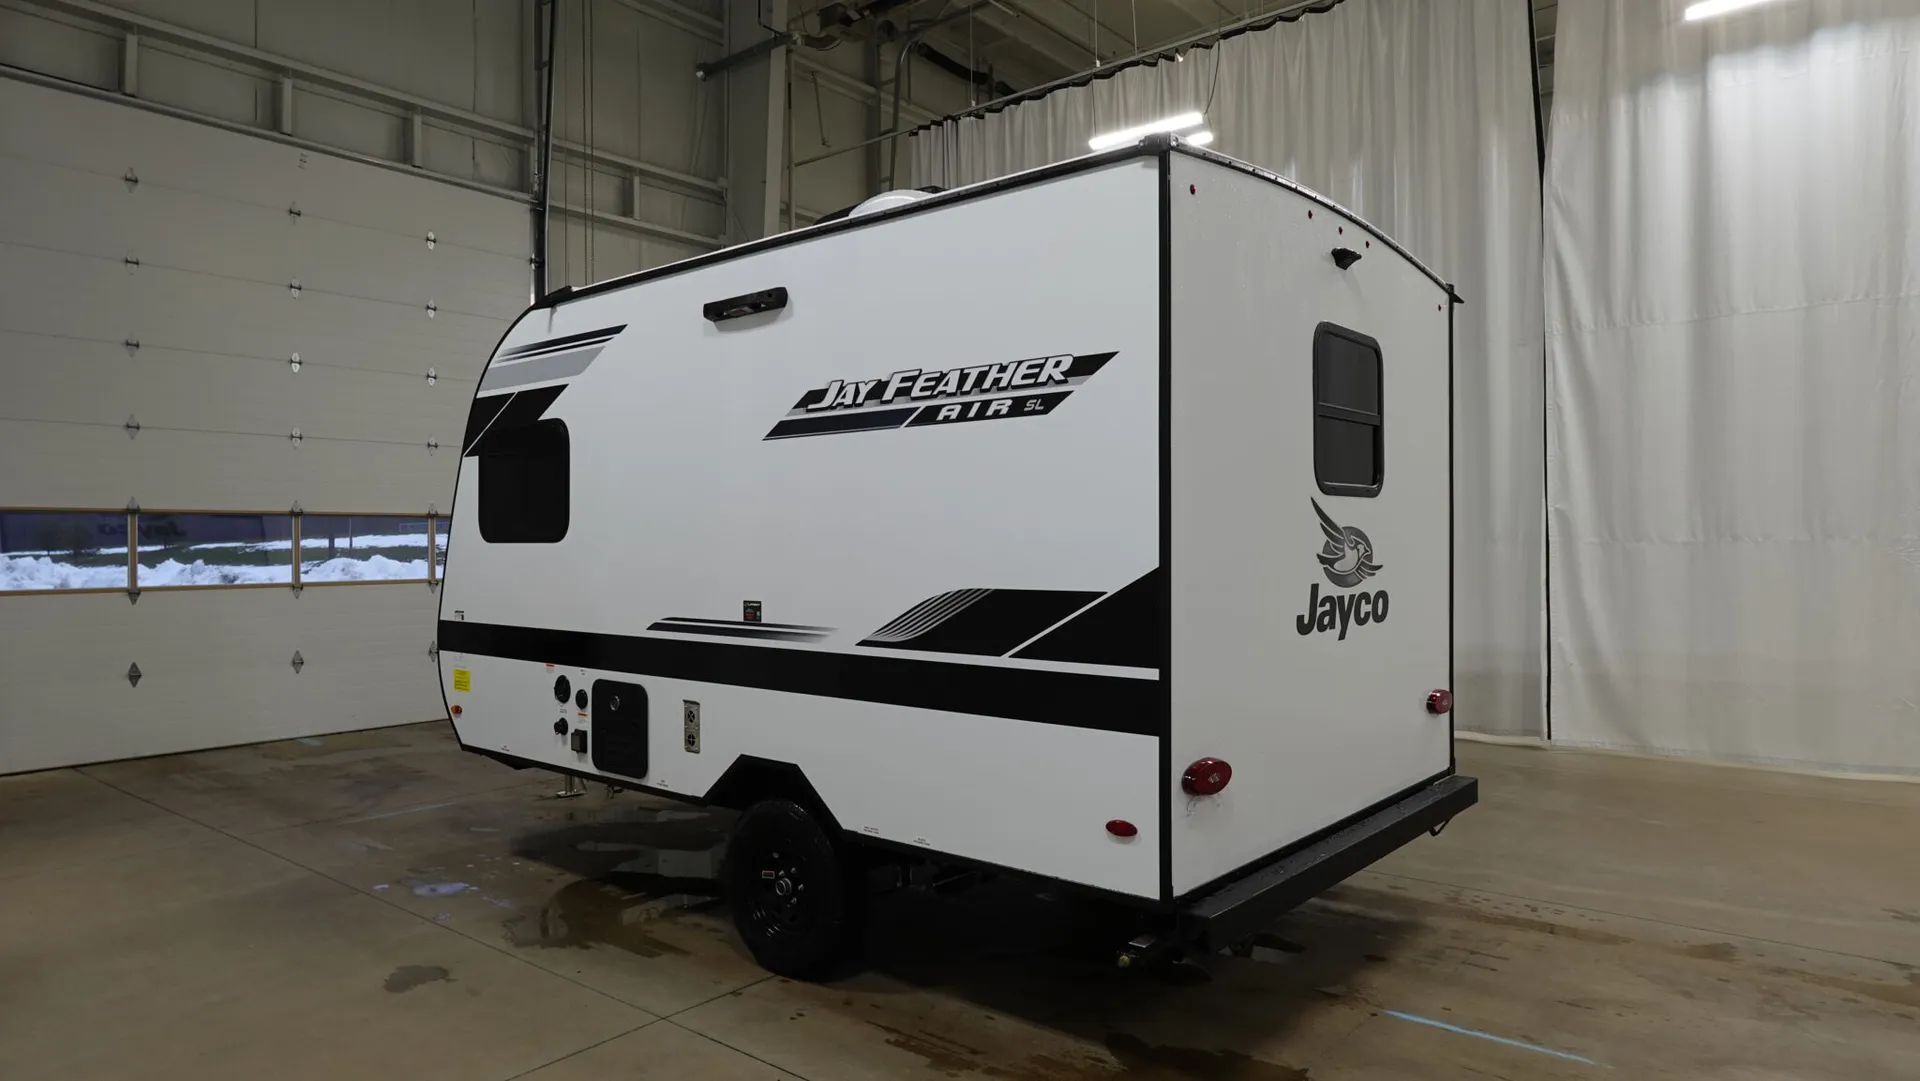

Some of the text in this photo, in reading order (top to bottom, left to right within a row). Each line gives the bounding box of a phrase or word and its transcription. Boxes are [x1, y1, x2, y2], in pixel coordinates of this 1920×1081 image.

[807, 354, 1074, 412] JAY FEATHER
[936, 398, 1045, 421] AIR SL
[1296, 583, 1389, 641] Jayco
